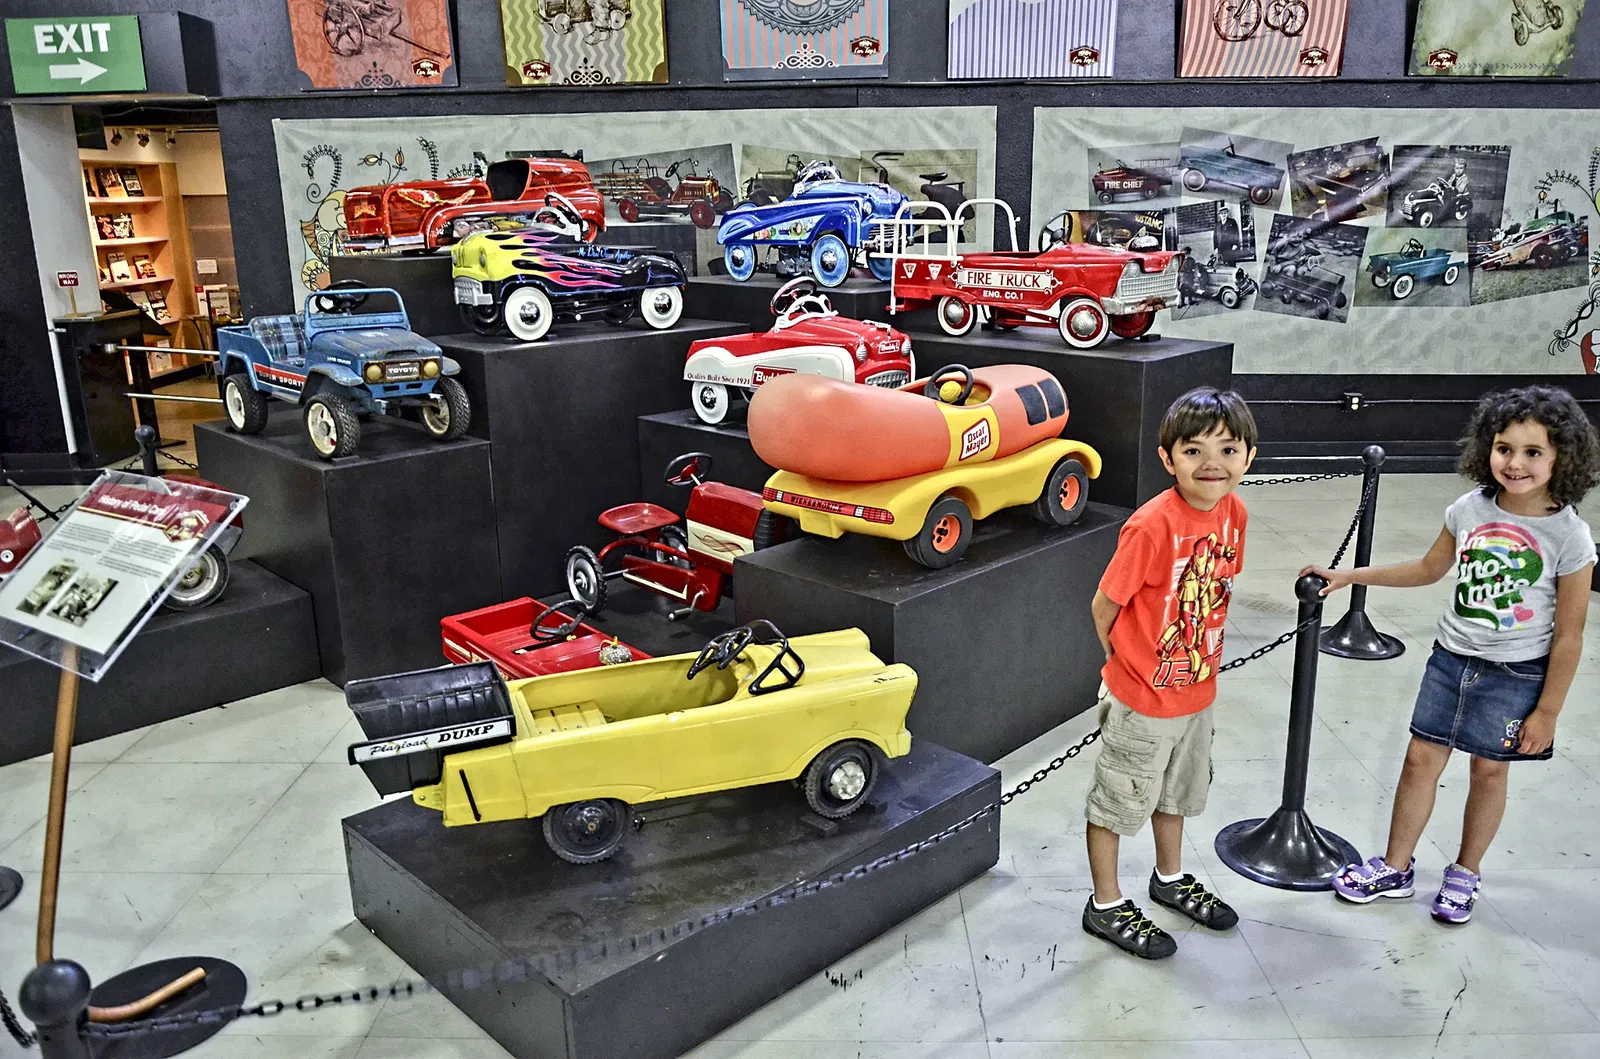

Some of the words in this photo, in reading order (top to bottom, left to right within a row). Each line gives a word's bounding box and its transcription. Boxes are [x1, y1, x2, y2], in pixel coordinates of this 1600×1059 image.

[34, 23, 111, 54] EXIT
[1104, 180, 1121, 189] FIRE
[1123, 180, 1144, 189] CHIEF
[967, 271, 992, 285] FIRE
[998, 273, 1041, 288] TRUCK
[983, 289, 1002, 298] ENG.
[388, 366, 418, 374] TOYOTA
[967, 426, 985, 443] Oscar
[965, 435, 988, 454] Mayer
[438, 723, 495, 743] DUMP
